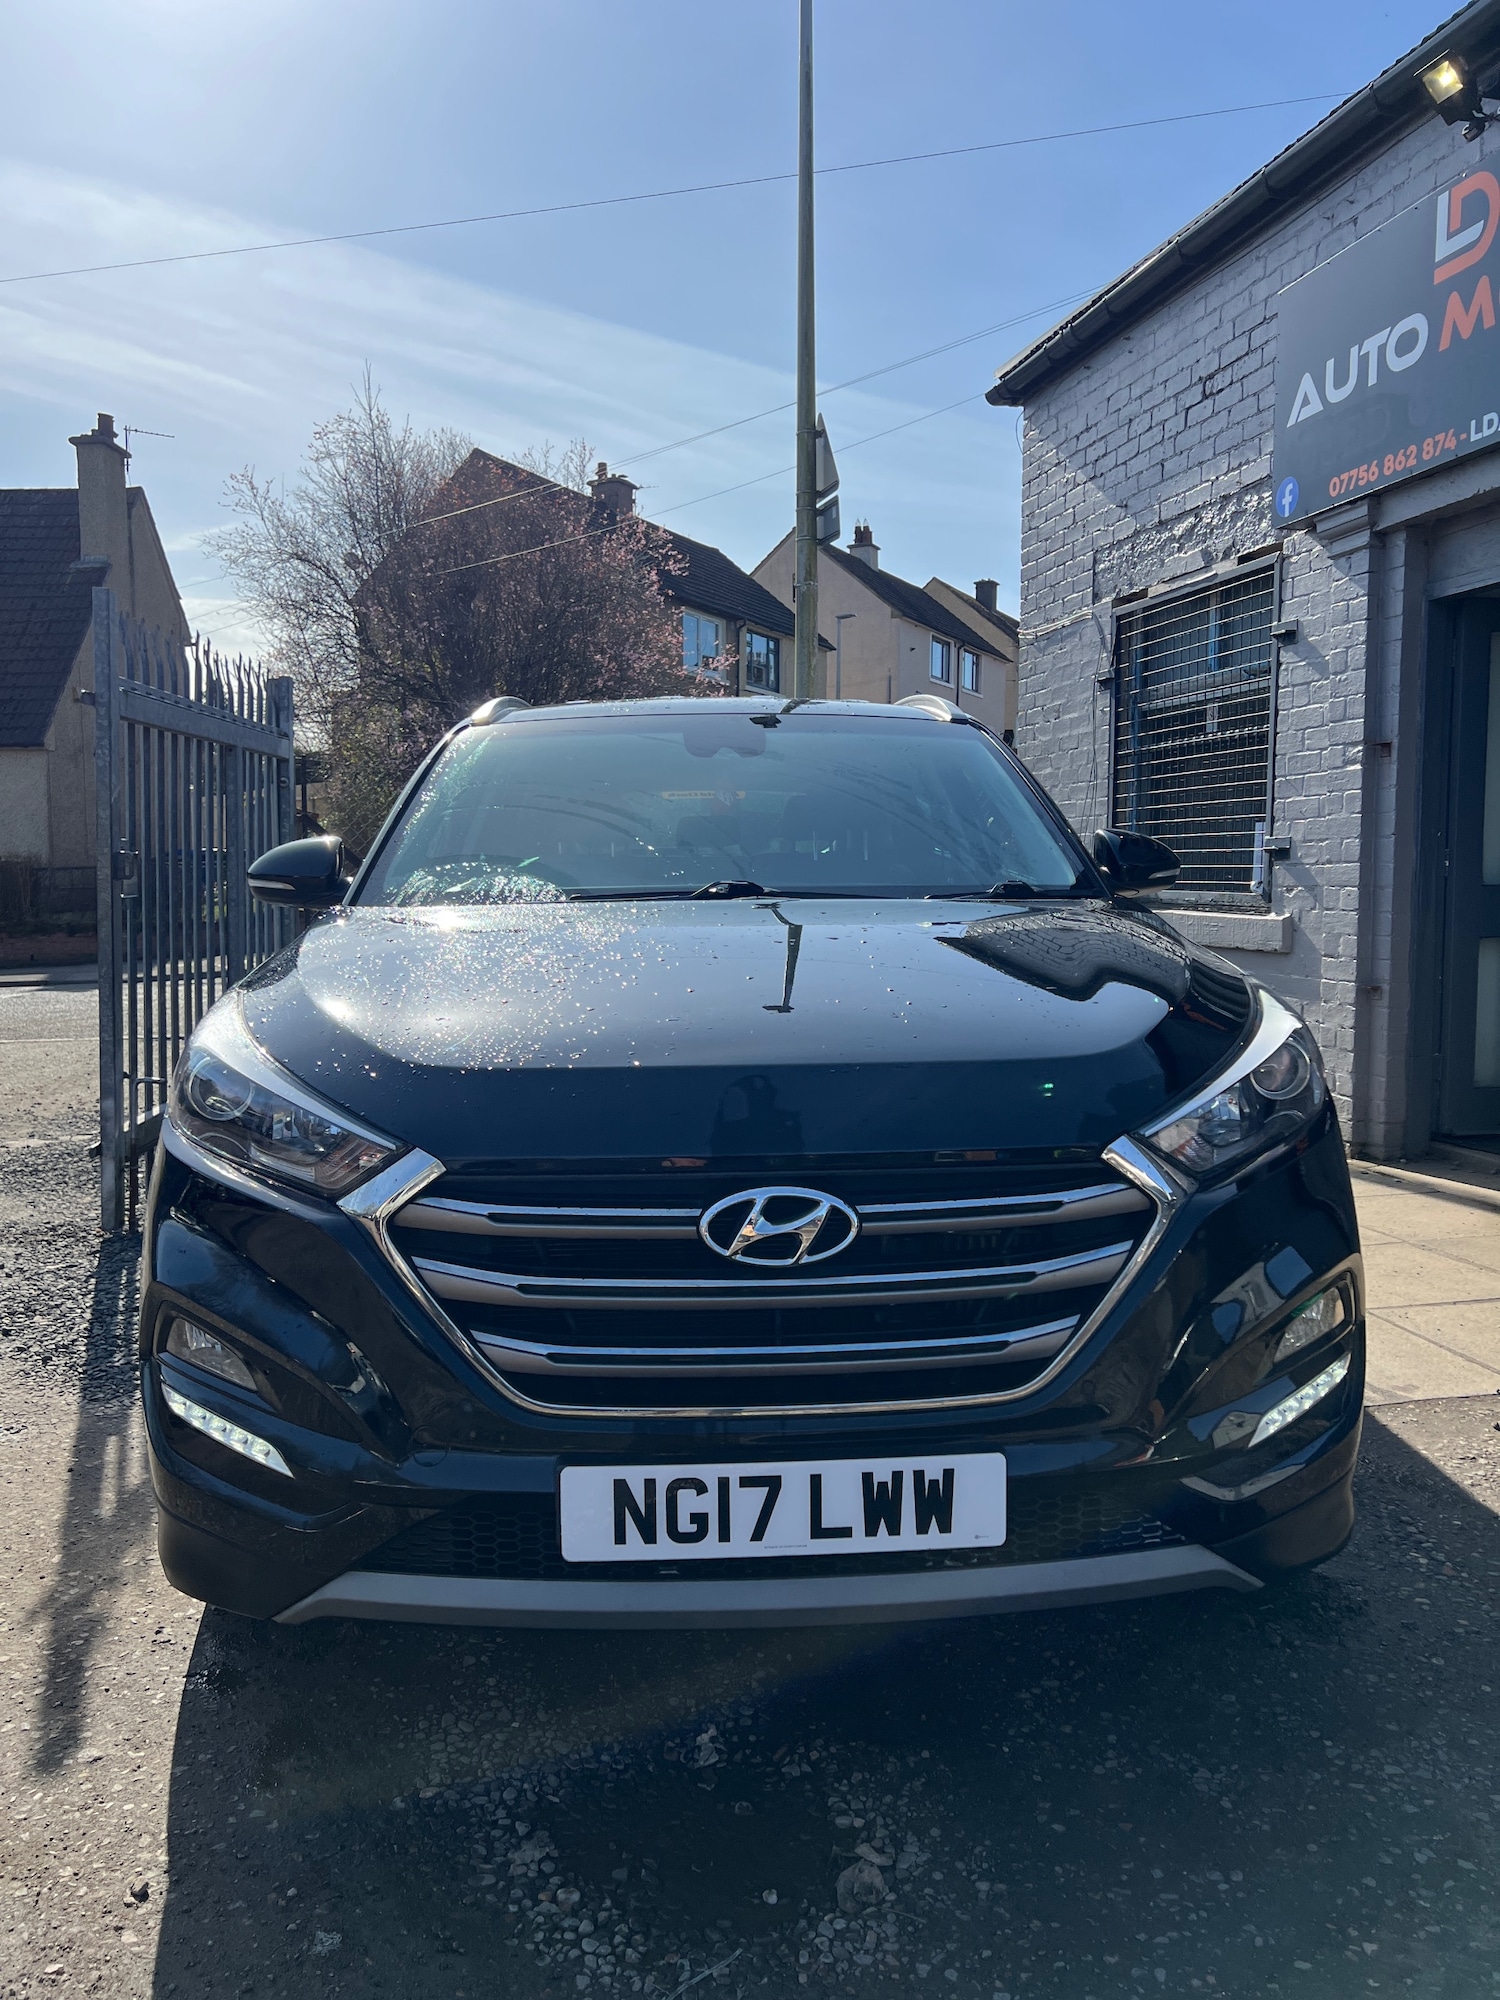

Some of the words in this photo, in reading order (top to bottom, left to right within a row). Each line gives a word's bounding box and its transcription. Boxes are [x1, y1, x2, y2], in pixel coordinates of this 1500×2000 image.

[1287, 312, 1429, 428] AUTO
[1439, 275, 1500, 352] M
[1329, 460, 1379, 497] 07756
[1383, 445, 1418, 476] 862
[1422, 428, 1457, 461] 874
[1470, 412, 1500, 442] LD
[613, 1475, 782, 1545] NG17
[810, 1468, 955, 1540] LWW
